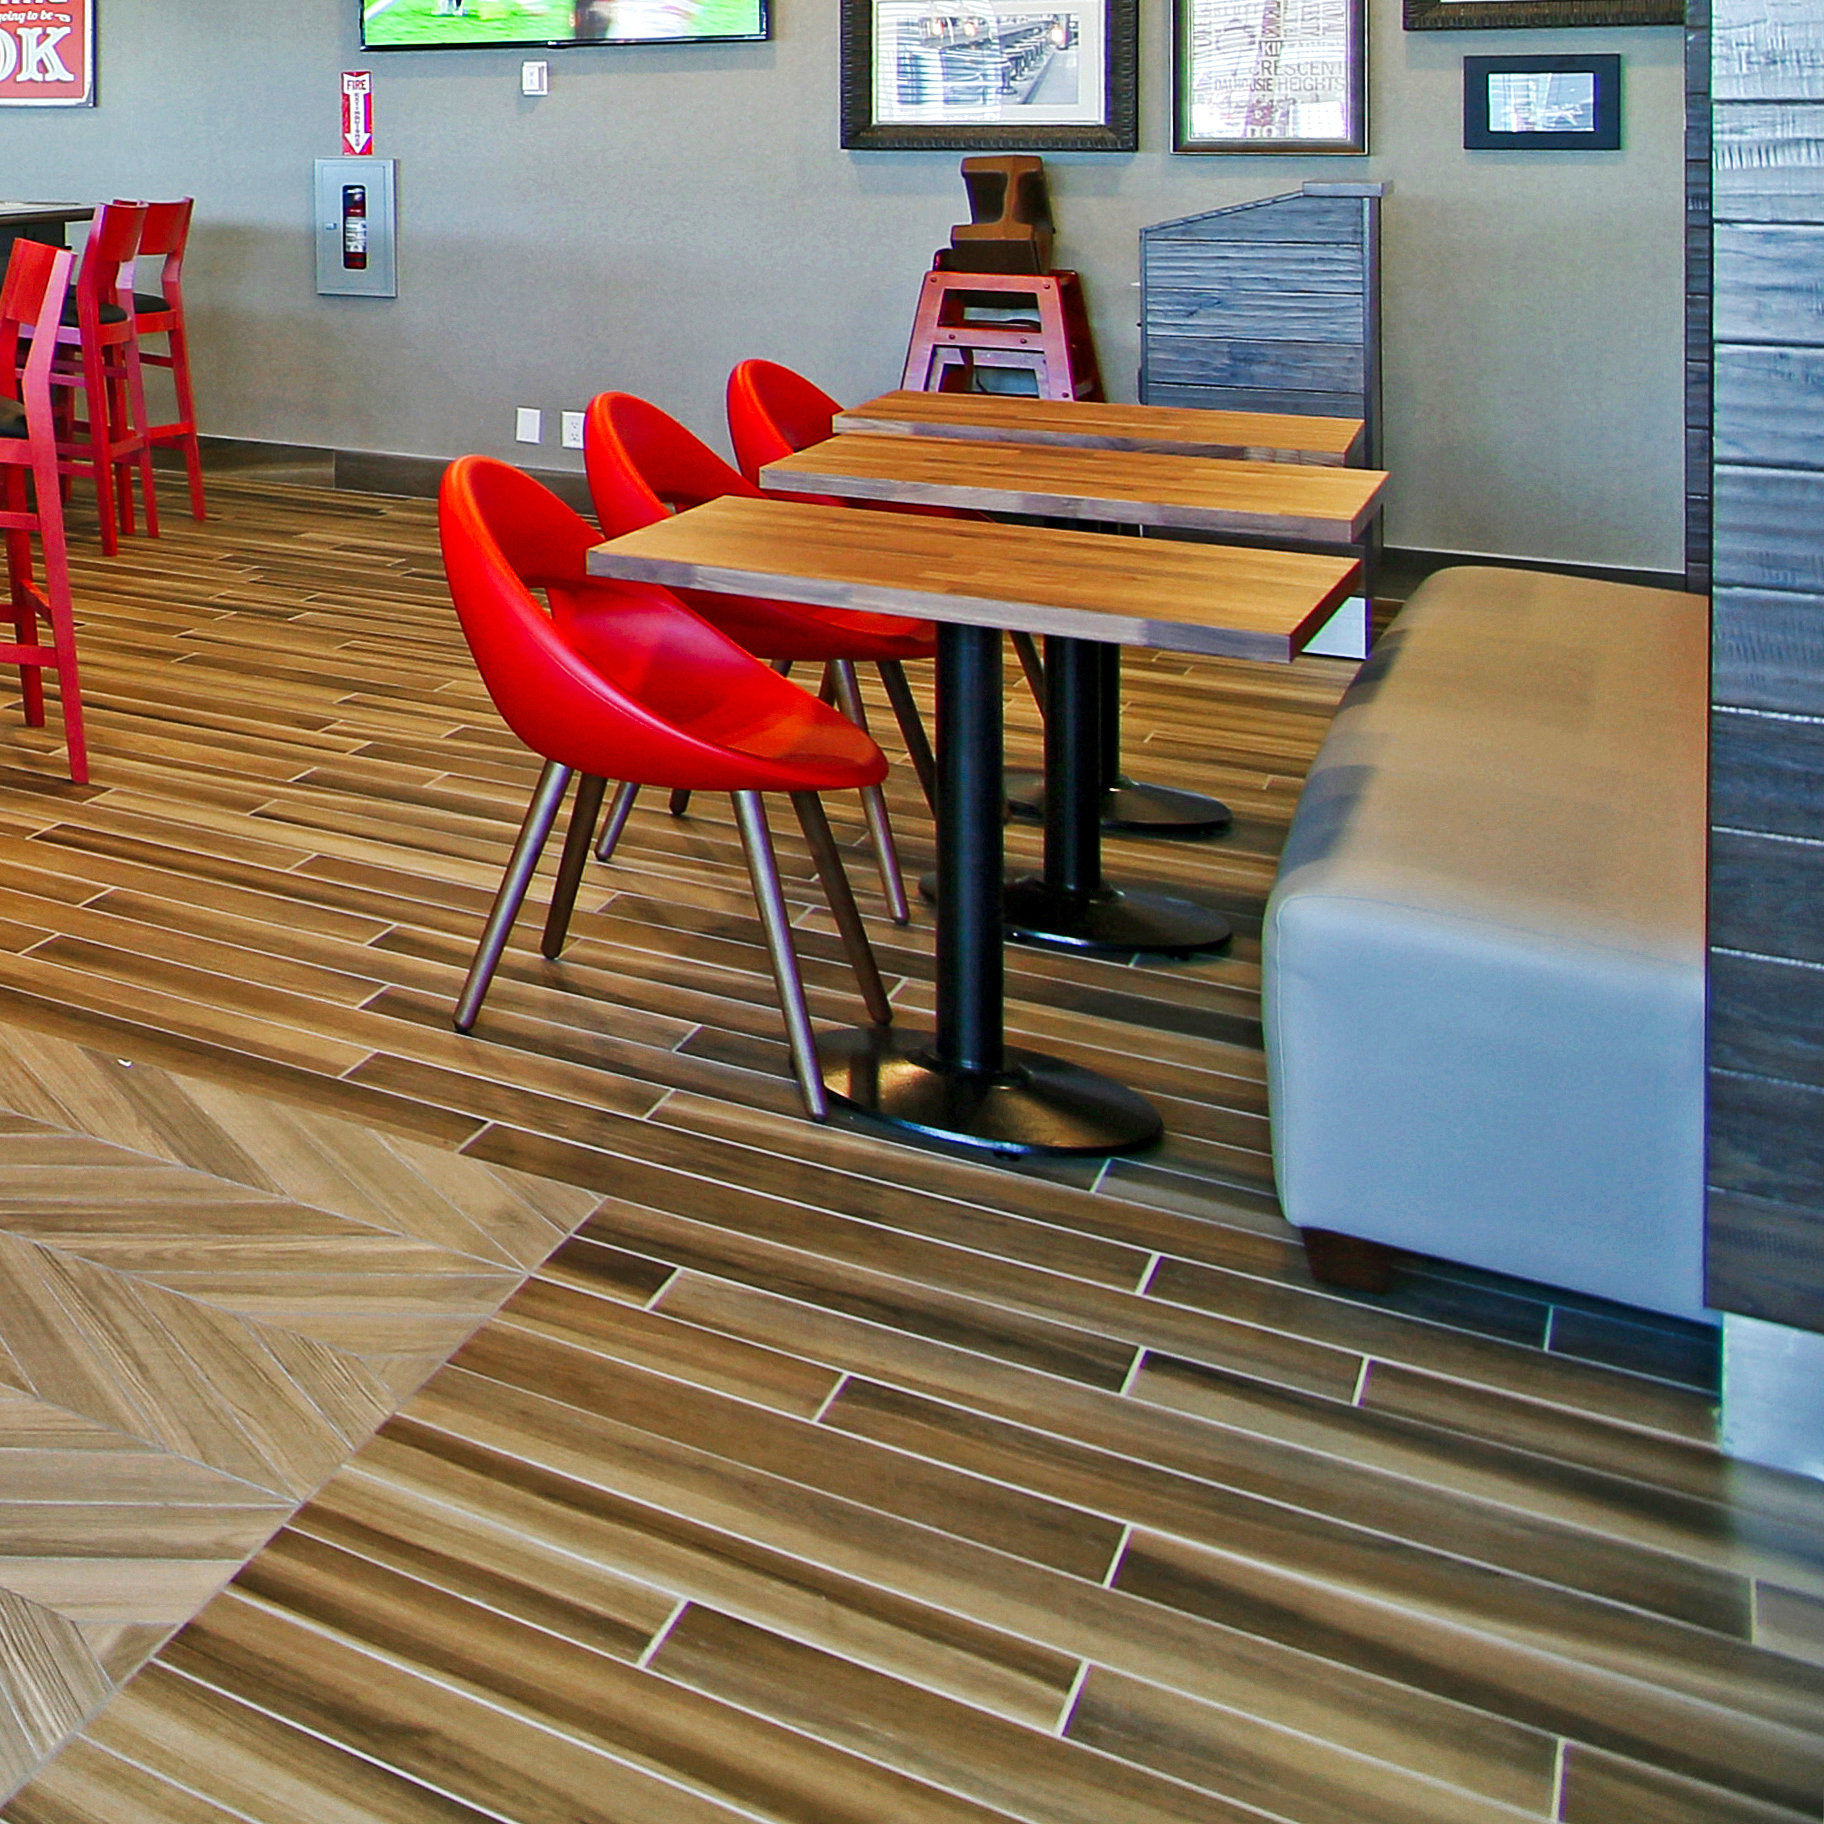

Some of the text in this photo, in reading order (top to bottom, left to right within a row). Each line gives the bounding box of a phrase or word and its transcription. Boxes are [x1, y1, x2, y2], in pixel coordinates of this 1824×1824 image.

[27, 10, 38, 21] to
[40, 9, 54, 21] be
[346, 79, 367, 91] FIRE
[1278, 76, 1345, 92] HEIGHTS
